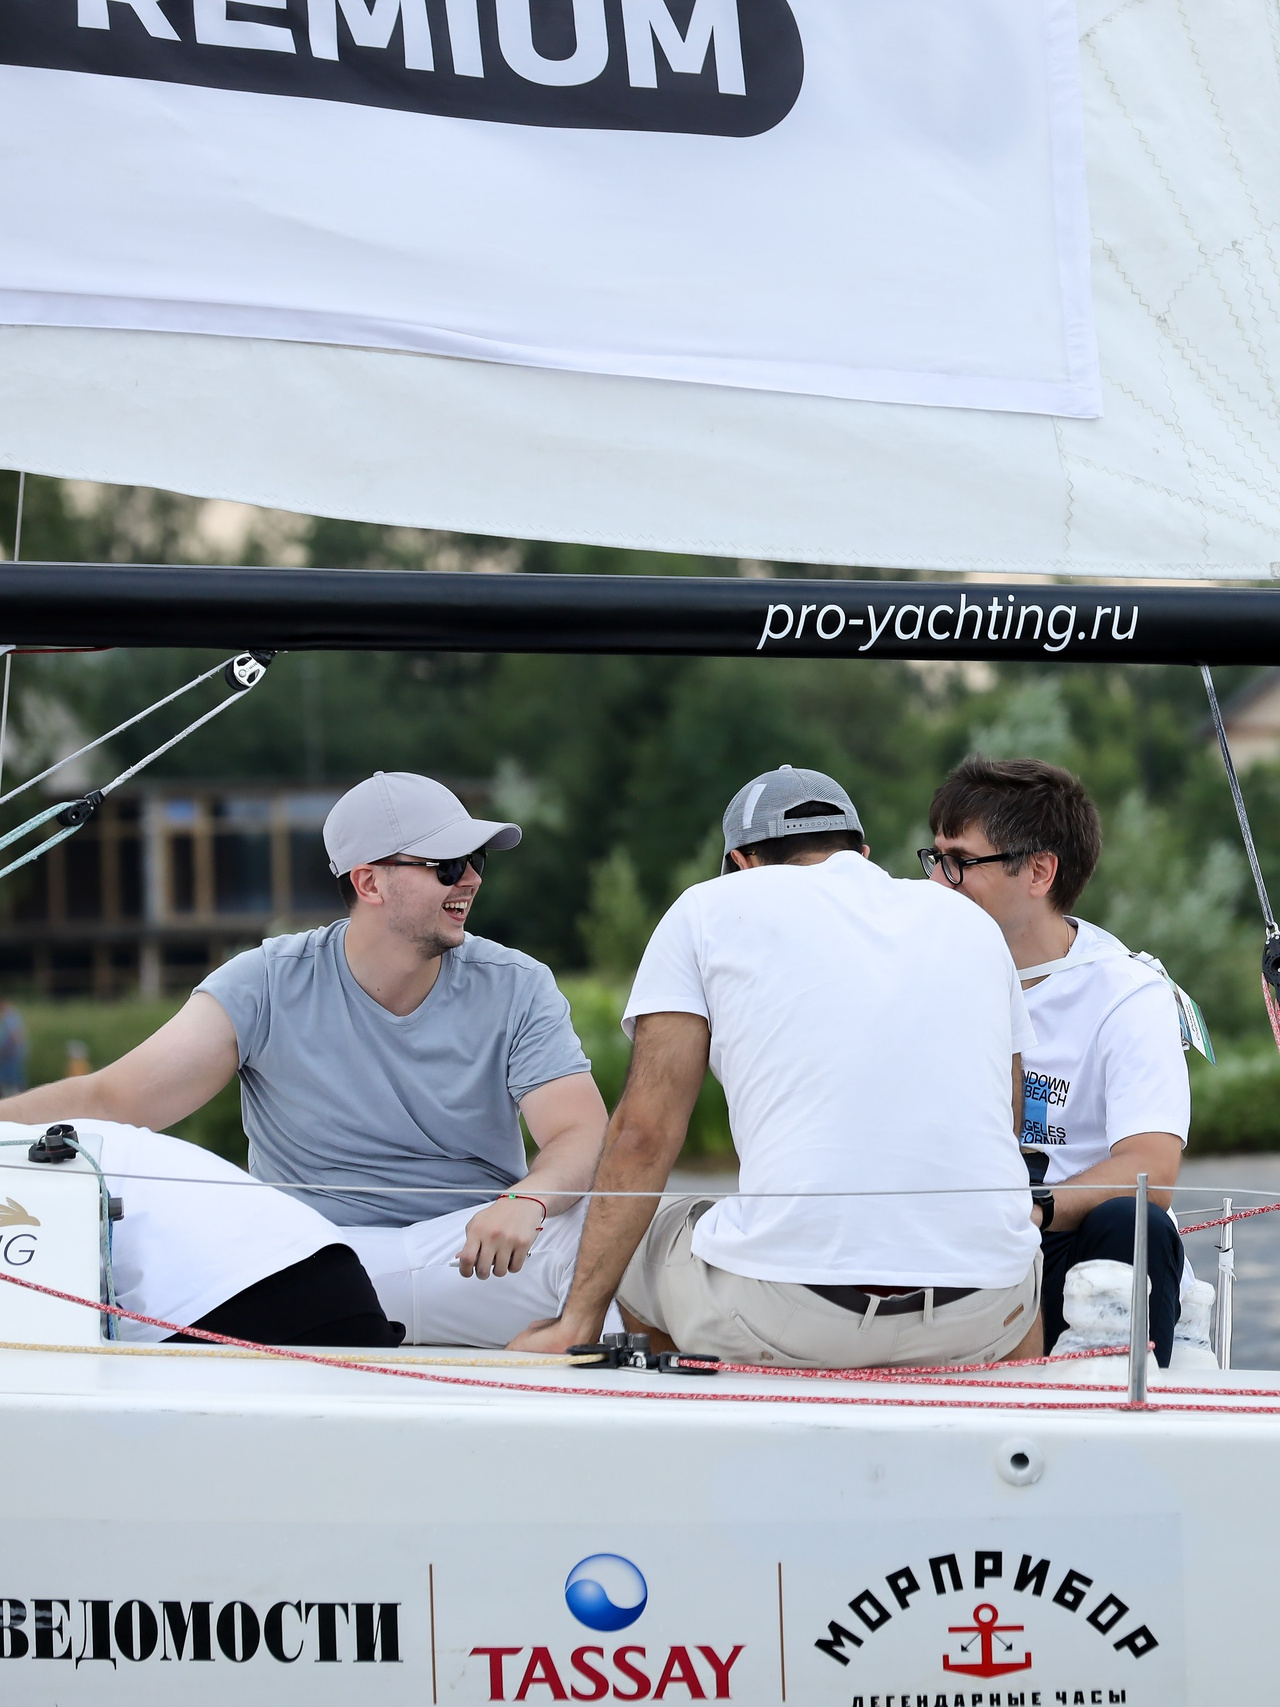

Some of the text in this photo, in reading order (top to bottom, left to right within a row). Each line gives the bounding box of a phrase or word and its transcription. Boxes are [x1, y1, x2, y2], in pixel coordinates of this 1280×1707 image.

[756, 593, 1139, 652] pro-yachting.ru
[1024, 1084, 1067, 1108] BEACH
[1021, 1131, 1067, 1145] ORNIA
[1023, 1119, 1067, 1139] GELES
[814, 1550, 1160, 1667] МОРПРИБОР
[0, 1598, 404, 1670] ВЕДОМОСТИ
[468, 1645, 747, 1702] TASSAY
[852, 1689, 1127, 1707] ЛЕГЕНДАРНЫЕ ЧАСЫ
